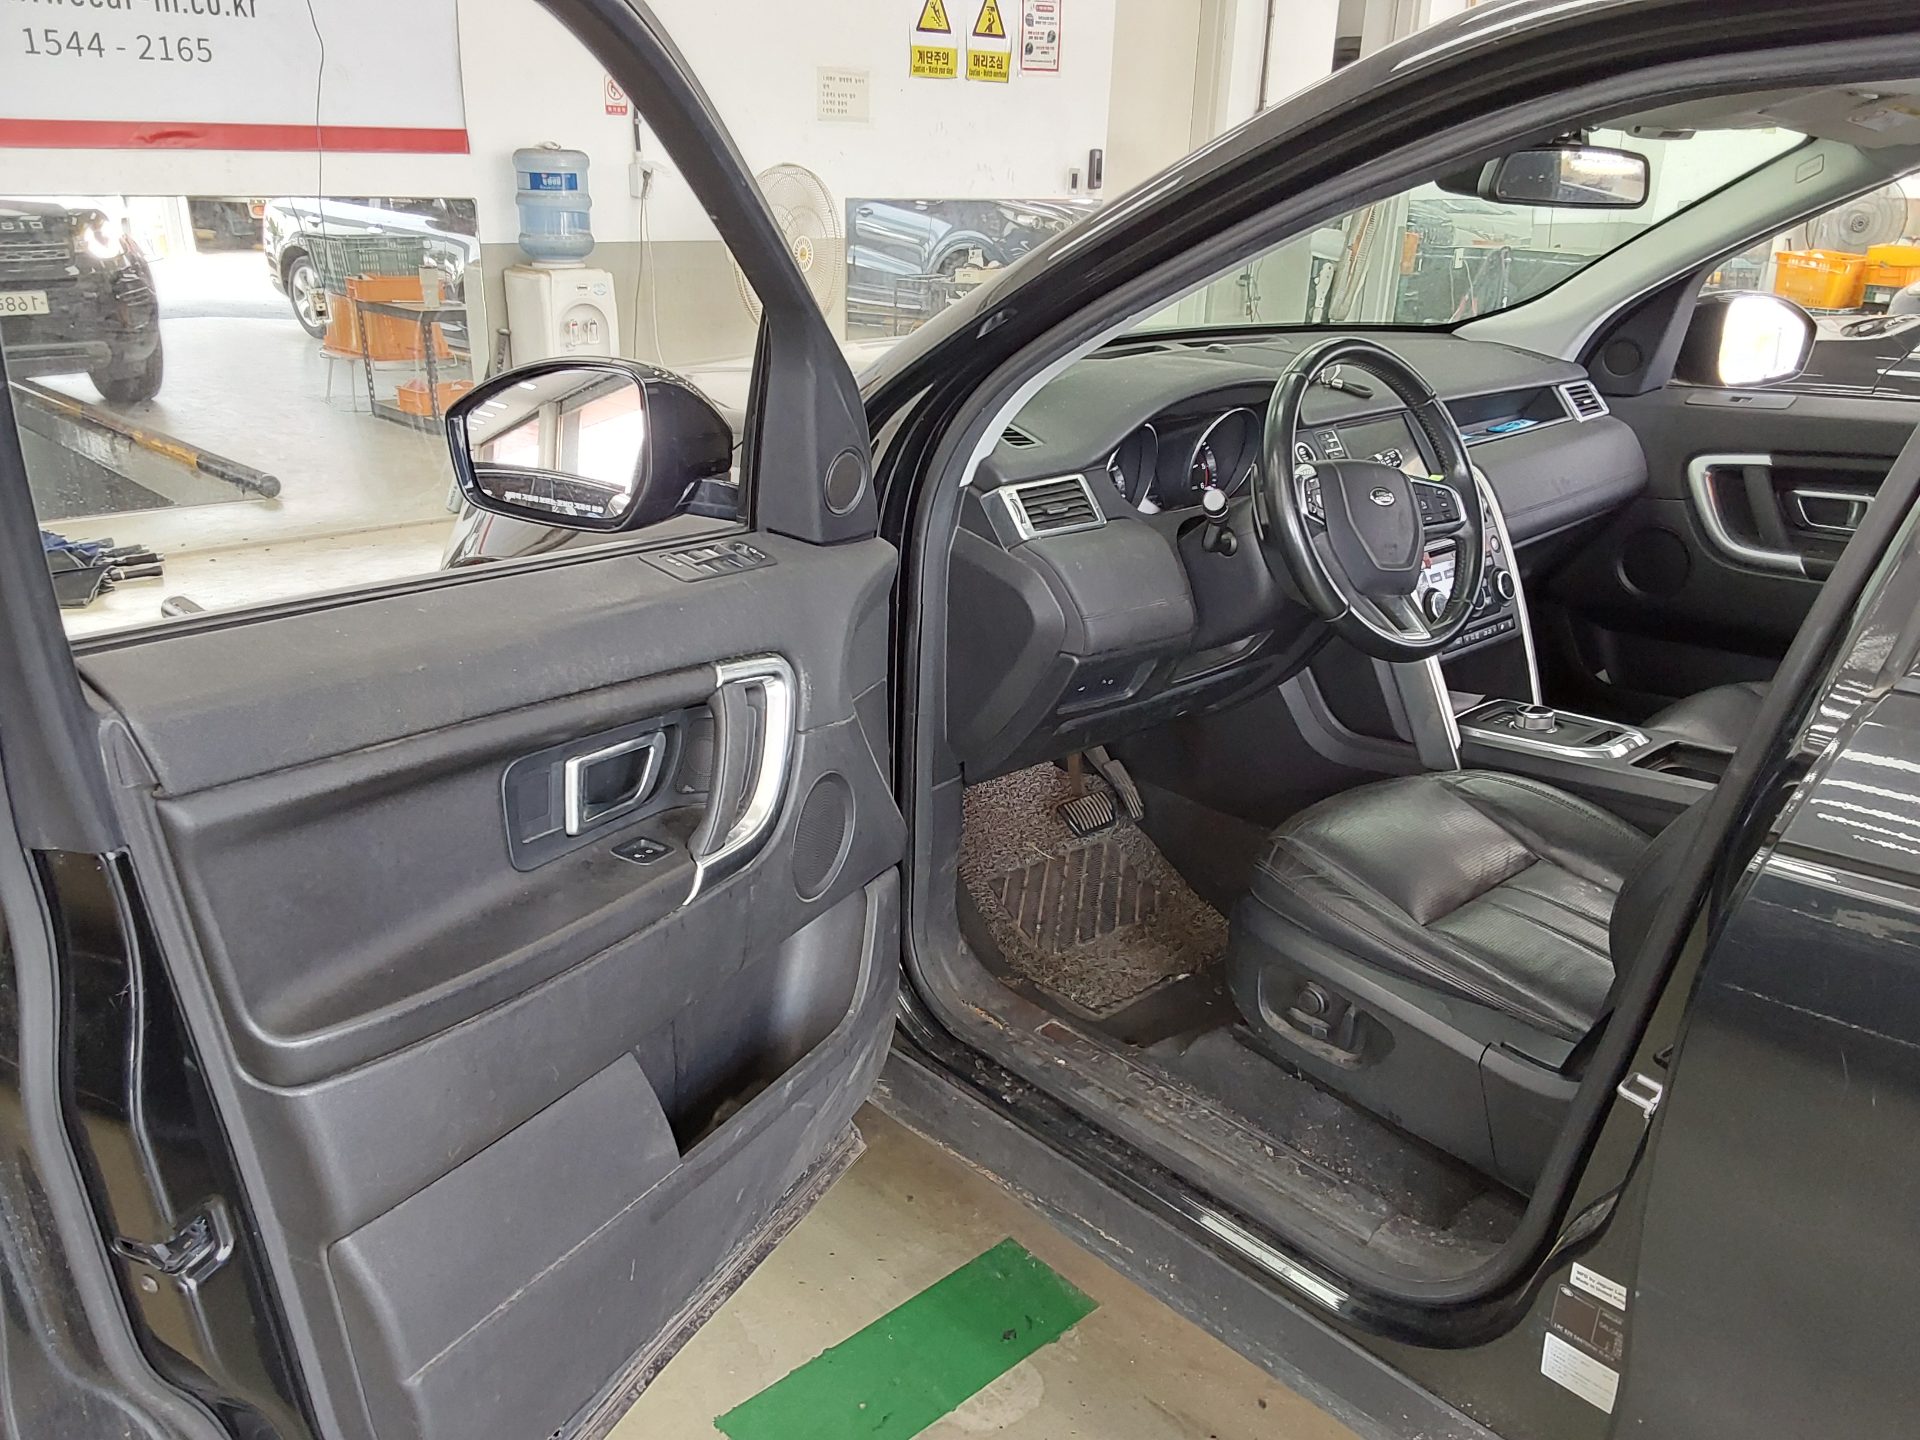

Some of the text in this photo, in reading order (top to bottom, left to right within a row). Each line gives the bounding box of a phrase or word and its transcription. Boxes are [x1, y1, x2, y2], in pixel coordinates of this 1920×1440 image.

[22, 27, 106, 58] 1544
[136, 34, 213, 63] 2165
[917, 49, 949, 66] 계단주의
[973, 54, 1003, 69] 머리조심
